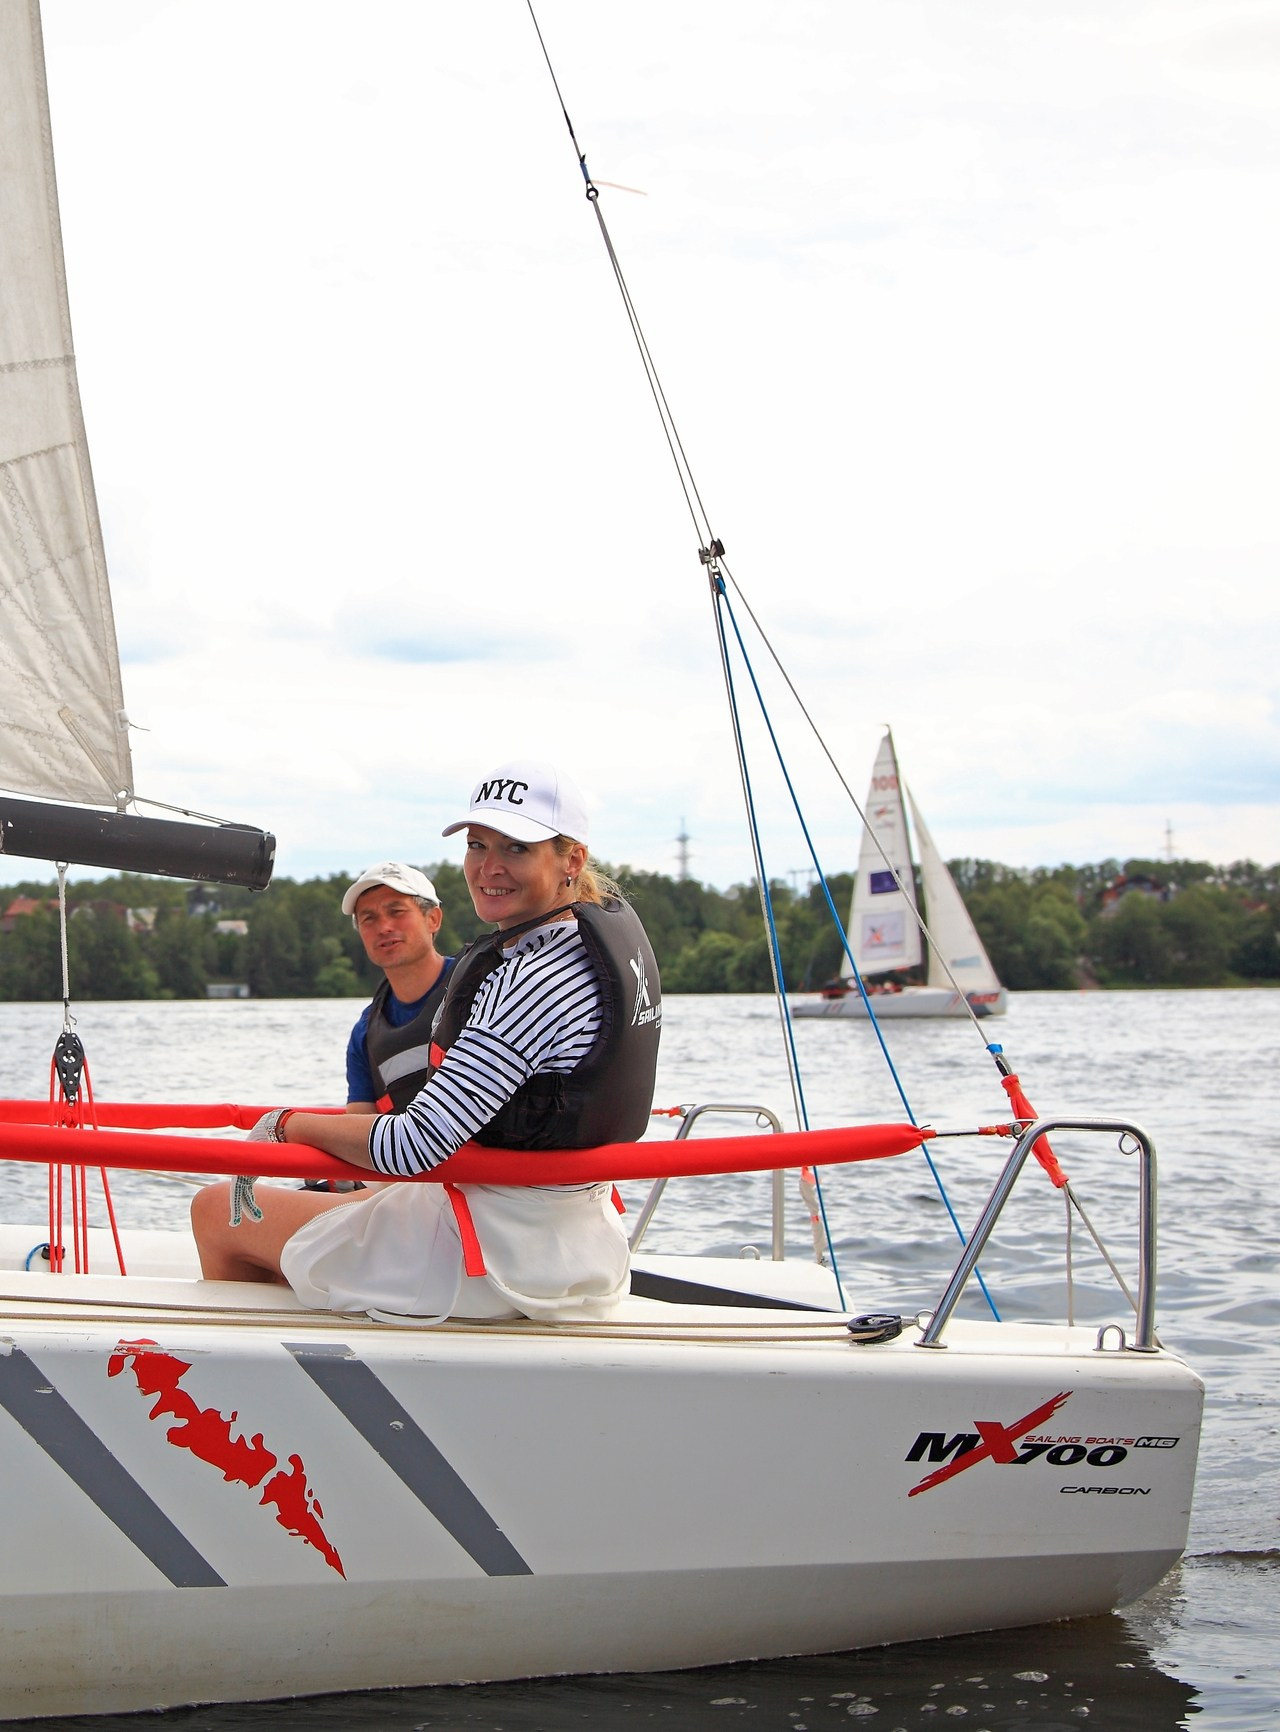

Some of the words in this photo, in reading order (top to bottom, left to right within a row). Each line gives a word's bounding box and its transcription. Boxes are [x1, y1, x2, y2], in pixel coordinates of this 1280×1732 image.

[475, 779, 529, 806] NYC
[1023, 1435, 1082, 1444] SAILING
[1085, 1437, 1135, 1446] BOATS
[1136, 1437, 1177, 1448] MG
[1060, 1486, 1152, 1496] CARBON
